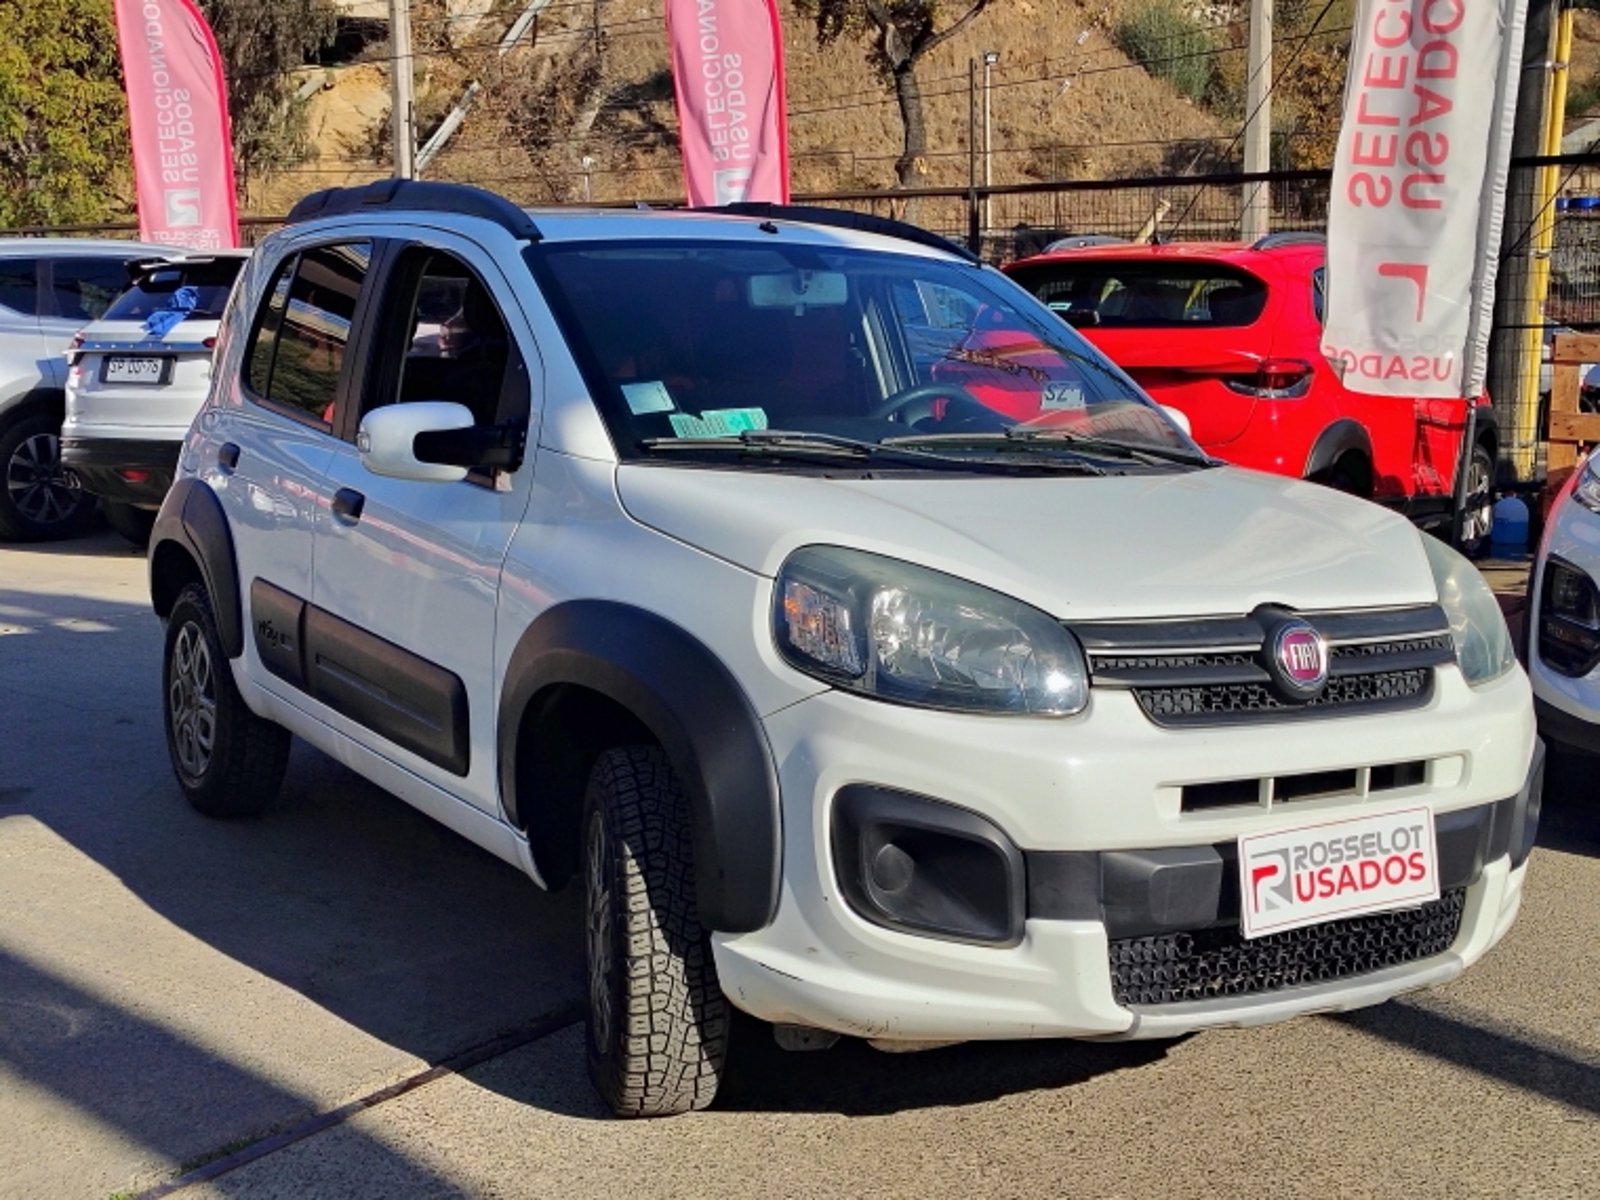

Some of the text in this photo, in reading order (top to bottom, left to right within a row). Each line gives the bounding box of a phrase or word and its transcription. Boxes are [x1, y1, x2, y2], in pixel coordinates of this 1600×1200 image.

[1289, 643, 1320, 671] FIAT
[1294, 824, 1424, 871] ROSSELOT
[1296, 851, 1427, 903] USADOS
